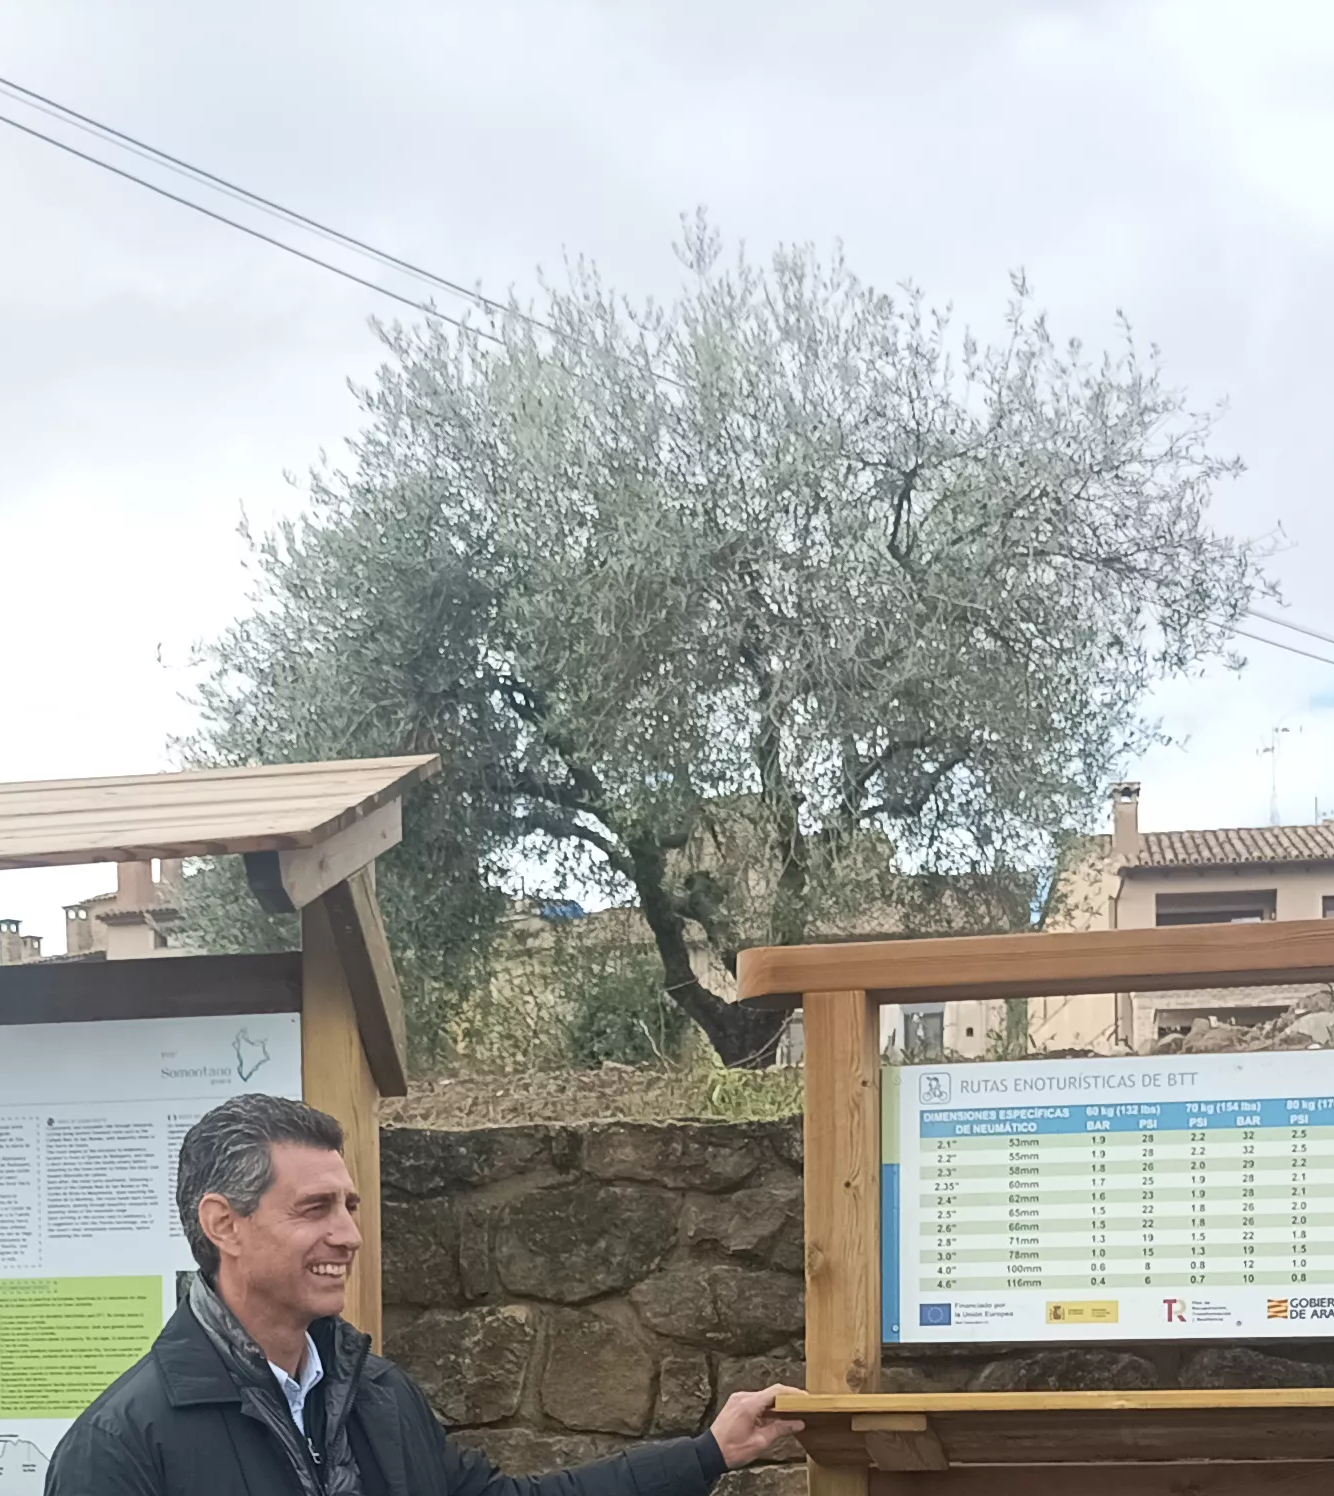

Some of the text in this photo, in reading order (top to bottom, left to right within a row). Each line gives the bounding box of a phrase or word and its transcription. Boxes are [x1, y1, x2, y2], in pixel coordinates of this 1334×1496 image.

[160, 1066, 232, 1079] Somontano
[959, 1071, 1199, 1094] RUTAS ENOTURÍSTICAS DE BTT
[1101, 1105, 1115, 1118] kg
[1115, 1104, 1139, 1118] (132
[1140, 1104, 1162, 1117] lbs)
[1185, 1100, 1262, 1115] 70 kg (154 lbs)
[1286, 1099, 1301, 1111] 80
[1302, 1099, 1316, 1112] kg
[922, 1106, 1070, 1123] DIMENSIONES ESPECÍFICAS
[1086, 1119, 1111, 1131] BAR
[1138, 1118, 1158, 1129] PSI
[1188, 1117, 1208, 1128] PSI
[1236, 1115, 1261, 1127] BAR
[1289, 1113, 1309, 1125] PSI
[955, 1121, 1038, 1135] DE NEUMÁTICO
[1008, 1137, 1040, 1148] 53mm
[1091, 1135, 1106, 1145] 1.9
[1141, 1133, 1154, 1144] 28
[1190, 1132, 1206, 1142] 2.2
[1242, 1130, 1255, 1141] 32
[1291, 1129, 1308, 1139] 2.5
[1008, 1166, 1040, 1176] 58mm
[1091, 1163, 1106, 1173] 1.8
[1142, 1162, 1154, 1172] 26
[1190, 1160, 1206, 1171] 2.0
[1242, 1159, 1255, 1169] 29
[1291, 1157, 1307, 1168] 2.2
[1008, 1179, 1040, 1190] 60mm
[1091, 1177, 1106, 1187] 1.7
[1141, 1176, 1155, 1186] 25
[1191, 1175, 1206, 1184] 1.9
[1242, 1173, 1255, 1184] 28
[1291, 1172, 1306, 1182] 2.1
[1008, 1193, 1040, 1204] 62mm
[1091, 1191, 1106, 1201] 1.6
[1142, 1190, 1154, 1200] 23
[1191, 1189, 1206, 1199] 1.9
[1242, 1187, 1255, 1198] 28
[1291, 1186, 1306, 1197] 2.1
[1008, 1208, 1040, 1218] 65mm
[1091, 1206, 1107, 1216] 1.5
[1141, 1204, 1155, 1214] 22
[1191, 1203, 1206, 1213] 1.8
[1242, 1202, 1255, 1212] 26
[1291, 1201, 1308, 1211] 2.0
[1009, 1236, 1040, 1245] 71mm
[1091, 1234, 1106, 1244] 1.3
[1142, 1233, 1155, 1243] 19
[1191, 1232, 1206, 1242] 1.5
[1242, 1231, 1255, 1241] 22
[1292, 1229, 1307, 1239] 1.8
[1008, 1250, 1040, 1260] 78mm
[1091, 1248, 1106, 1258] 1.0
[1142, 1247, 1155, 1257] 15
[1191, 1246, 1206, 1256] 1.3
[1243, 1245, 1255, 1255] 19
[1291, 1243, 1307, 1254] 1.5
[1006, 1278, 1042, 1288] 116mm
[1090, 1276, 1106, 1287] 0.4
[1189, 1274, 1206, 1285] 0.7
[1242, 1273, 1255, 1284] 10
[1290, 1272, 1307, 1283] 0.8
[1289, 1308, 1307, 1320] DE
